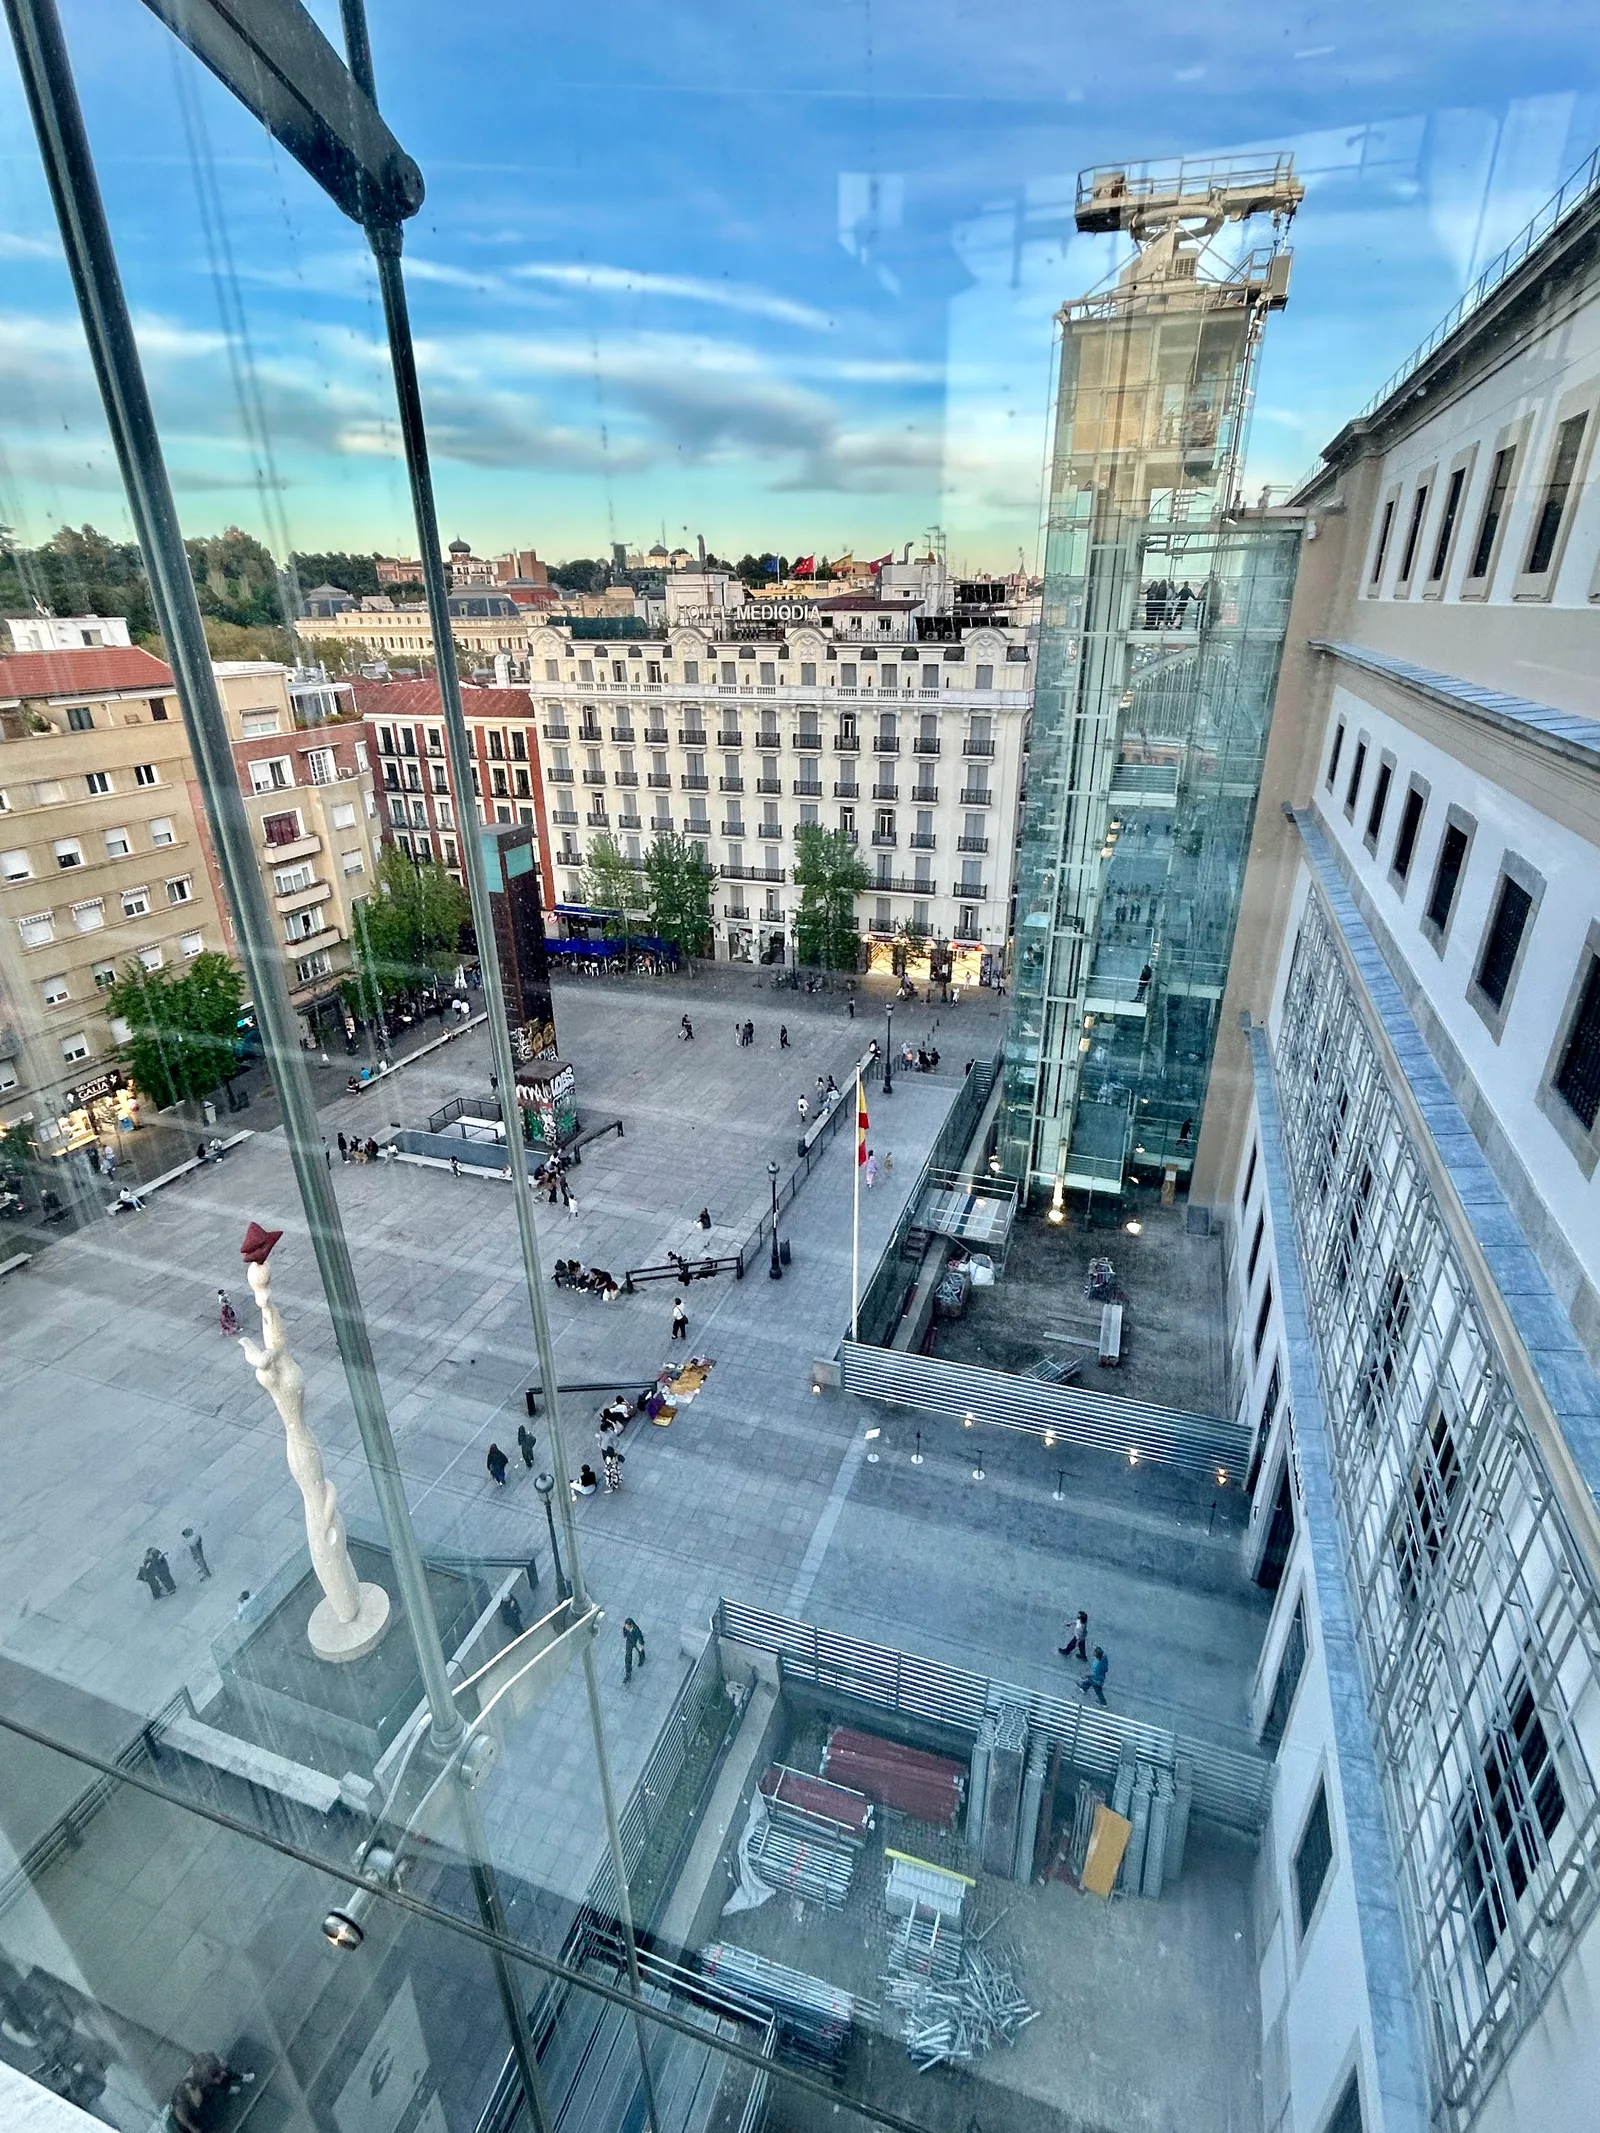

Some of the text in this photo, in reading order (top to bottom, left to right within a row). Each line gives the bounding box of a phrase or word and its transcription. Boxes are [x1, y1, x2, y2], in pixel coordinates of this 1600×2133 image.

[677, 604, 821, 620] HOTEL MEDIODIA
[75, 1076, 107, 1092] GELATERIA
